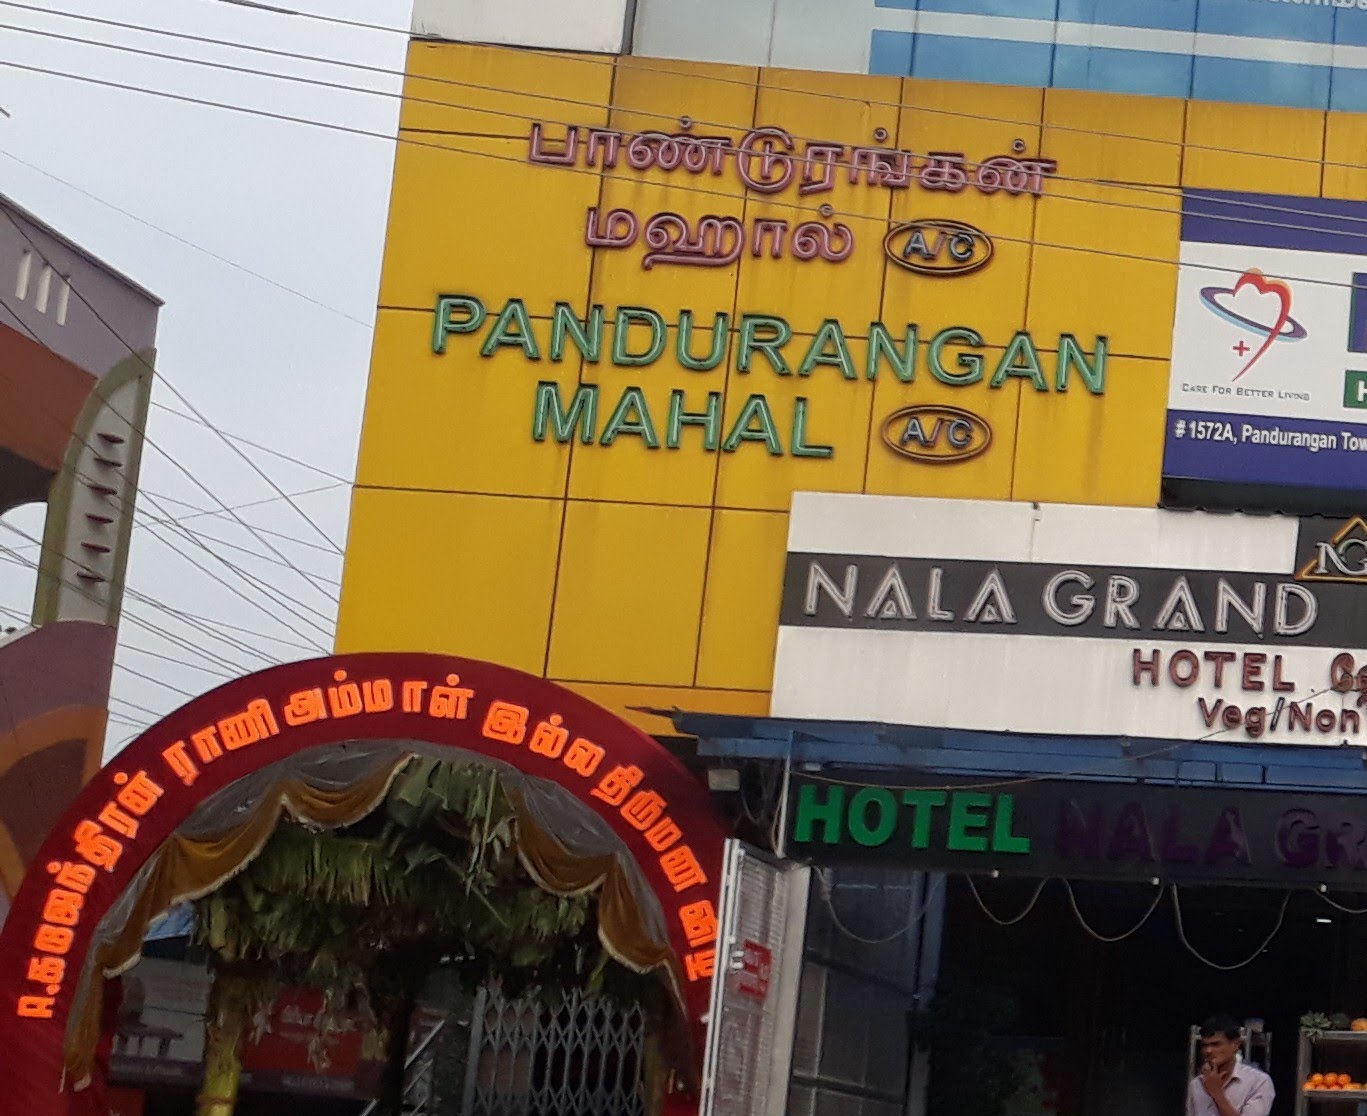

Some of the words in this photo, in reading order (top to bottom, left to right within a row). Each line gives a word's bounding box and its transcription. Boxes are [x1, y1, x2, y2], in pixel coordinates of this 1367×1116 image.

[527, 116, 1057, 197] பாண்டுரங்கன்
[585, 204, 853, 270] மஹால்
[904, 230, 975, 263] A/C
[432, 294, 1108, 395] PANDURANGAN
[533, 381, 833, 458] MAHAL
[902, 417, 973, 449] A/C
[1189, 421, 1238, 445] 1572A,
[1242, 424, 1337, 452] Pandurangan
[804, 562, 1018, 624] NALA
[1042, 569, 1319, 638] GRAND
[1132, 648, 1296, 692] HOTEL
[163, 698, 280, 787] ராணி
[283, 669, 475, 727] அம்மாள்
[794, 784, 1031, 855] HOTEL
[1055, 799, 1251, 865] NALA
